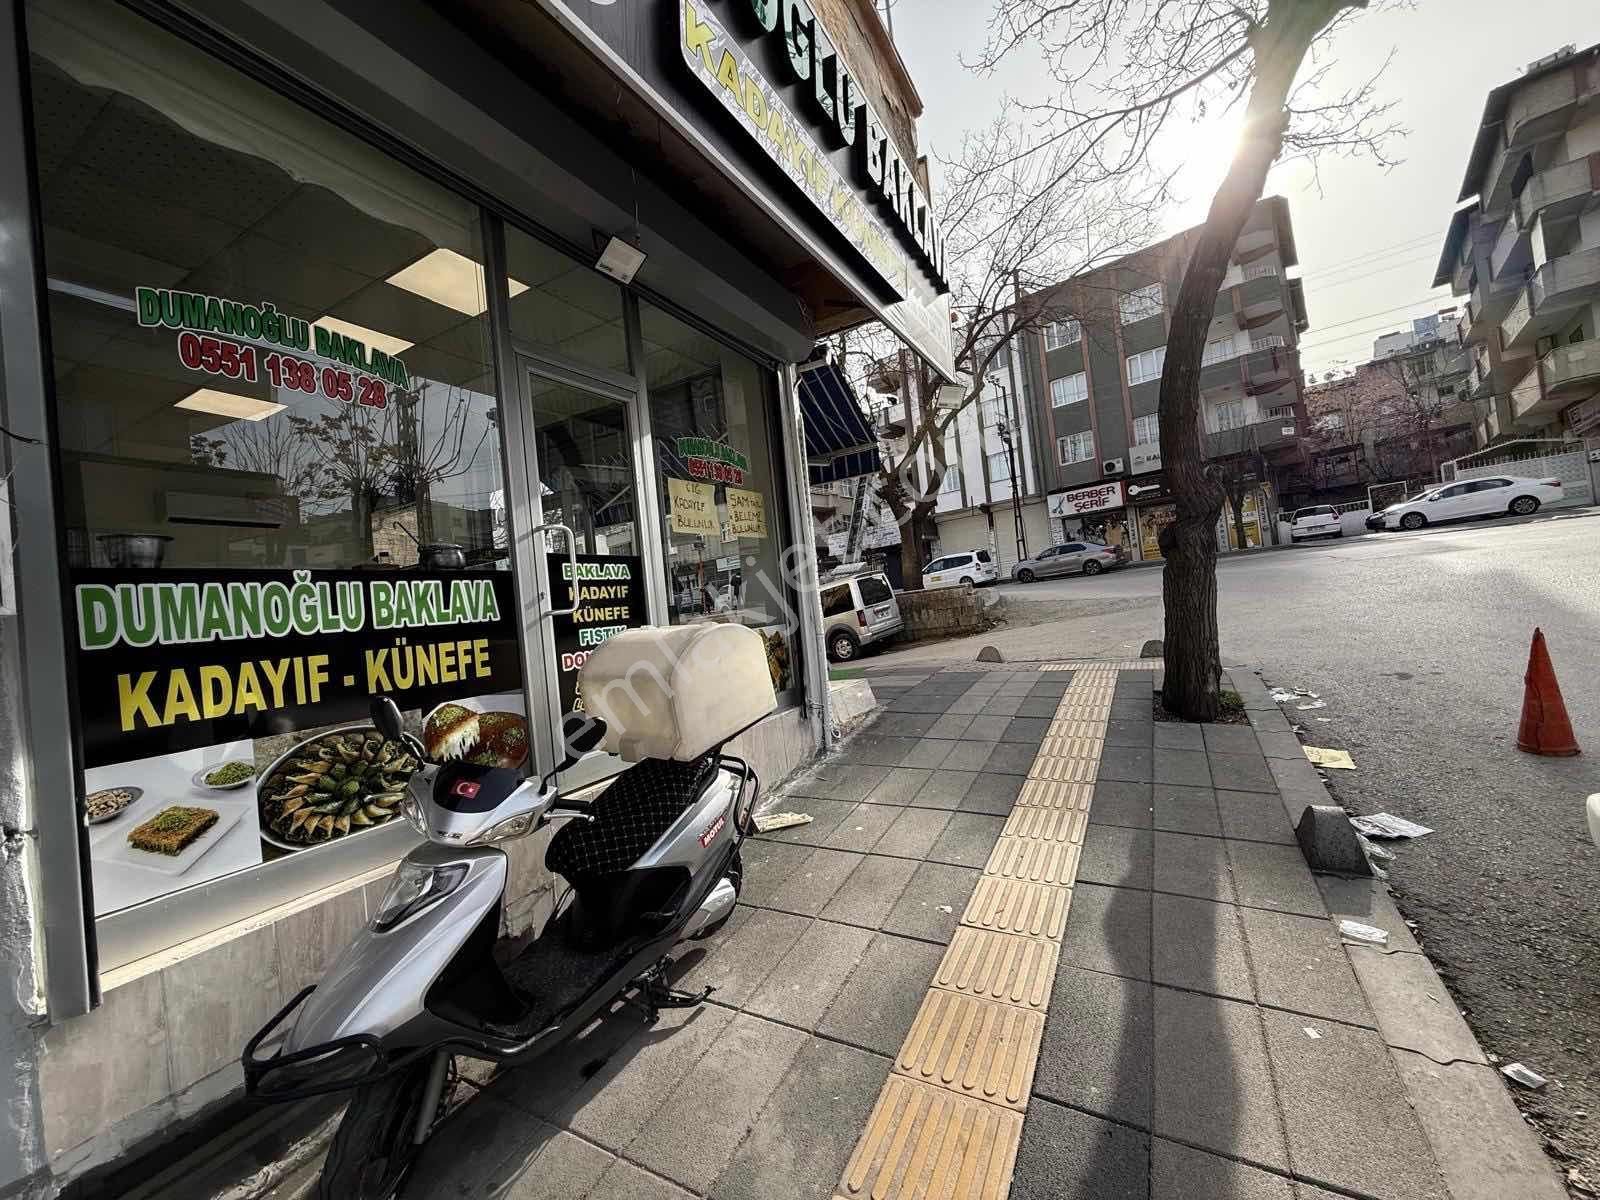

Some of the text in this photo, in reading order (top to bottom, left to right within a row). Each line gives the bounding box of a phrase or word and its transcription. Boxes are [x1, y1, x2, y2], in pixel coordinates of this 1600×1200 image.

[685, 0, 829, 195] KADAYIF
[136, 287, 410, 391] DUMANOĞLU BAKLAVA
[177, 331, 388, 410] 0551 138 05 28
[1067, 486, 1116, 503] BERBER
[75, 570, 500, 650] DUMANOĞLU BAKLAVA
[562, 563, 631, 580] BAKLAVA
[573, 606, 630, 623] KÜNEFE
[117, 637, 492, 731] KADAYIF - KÜNEFE
[703, 817, 725, 846] MOTUL
